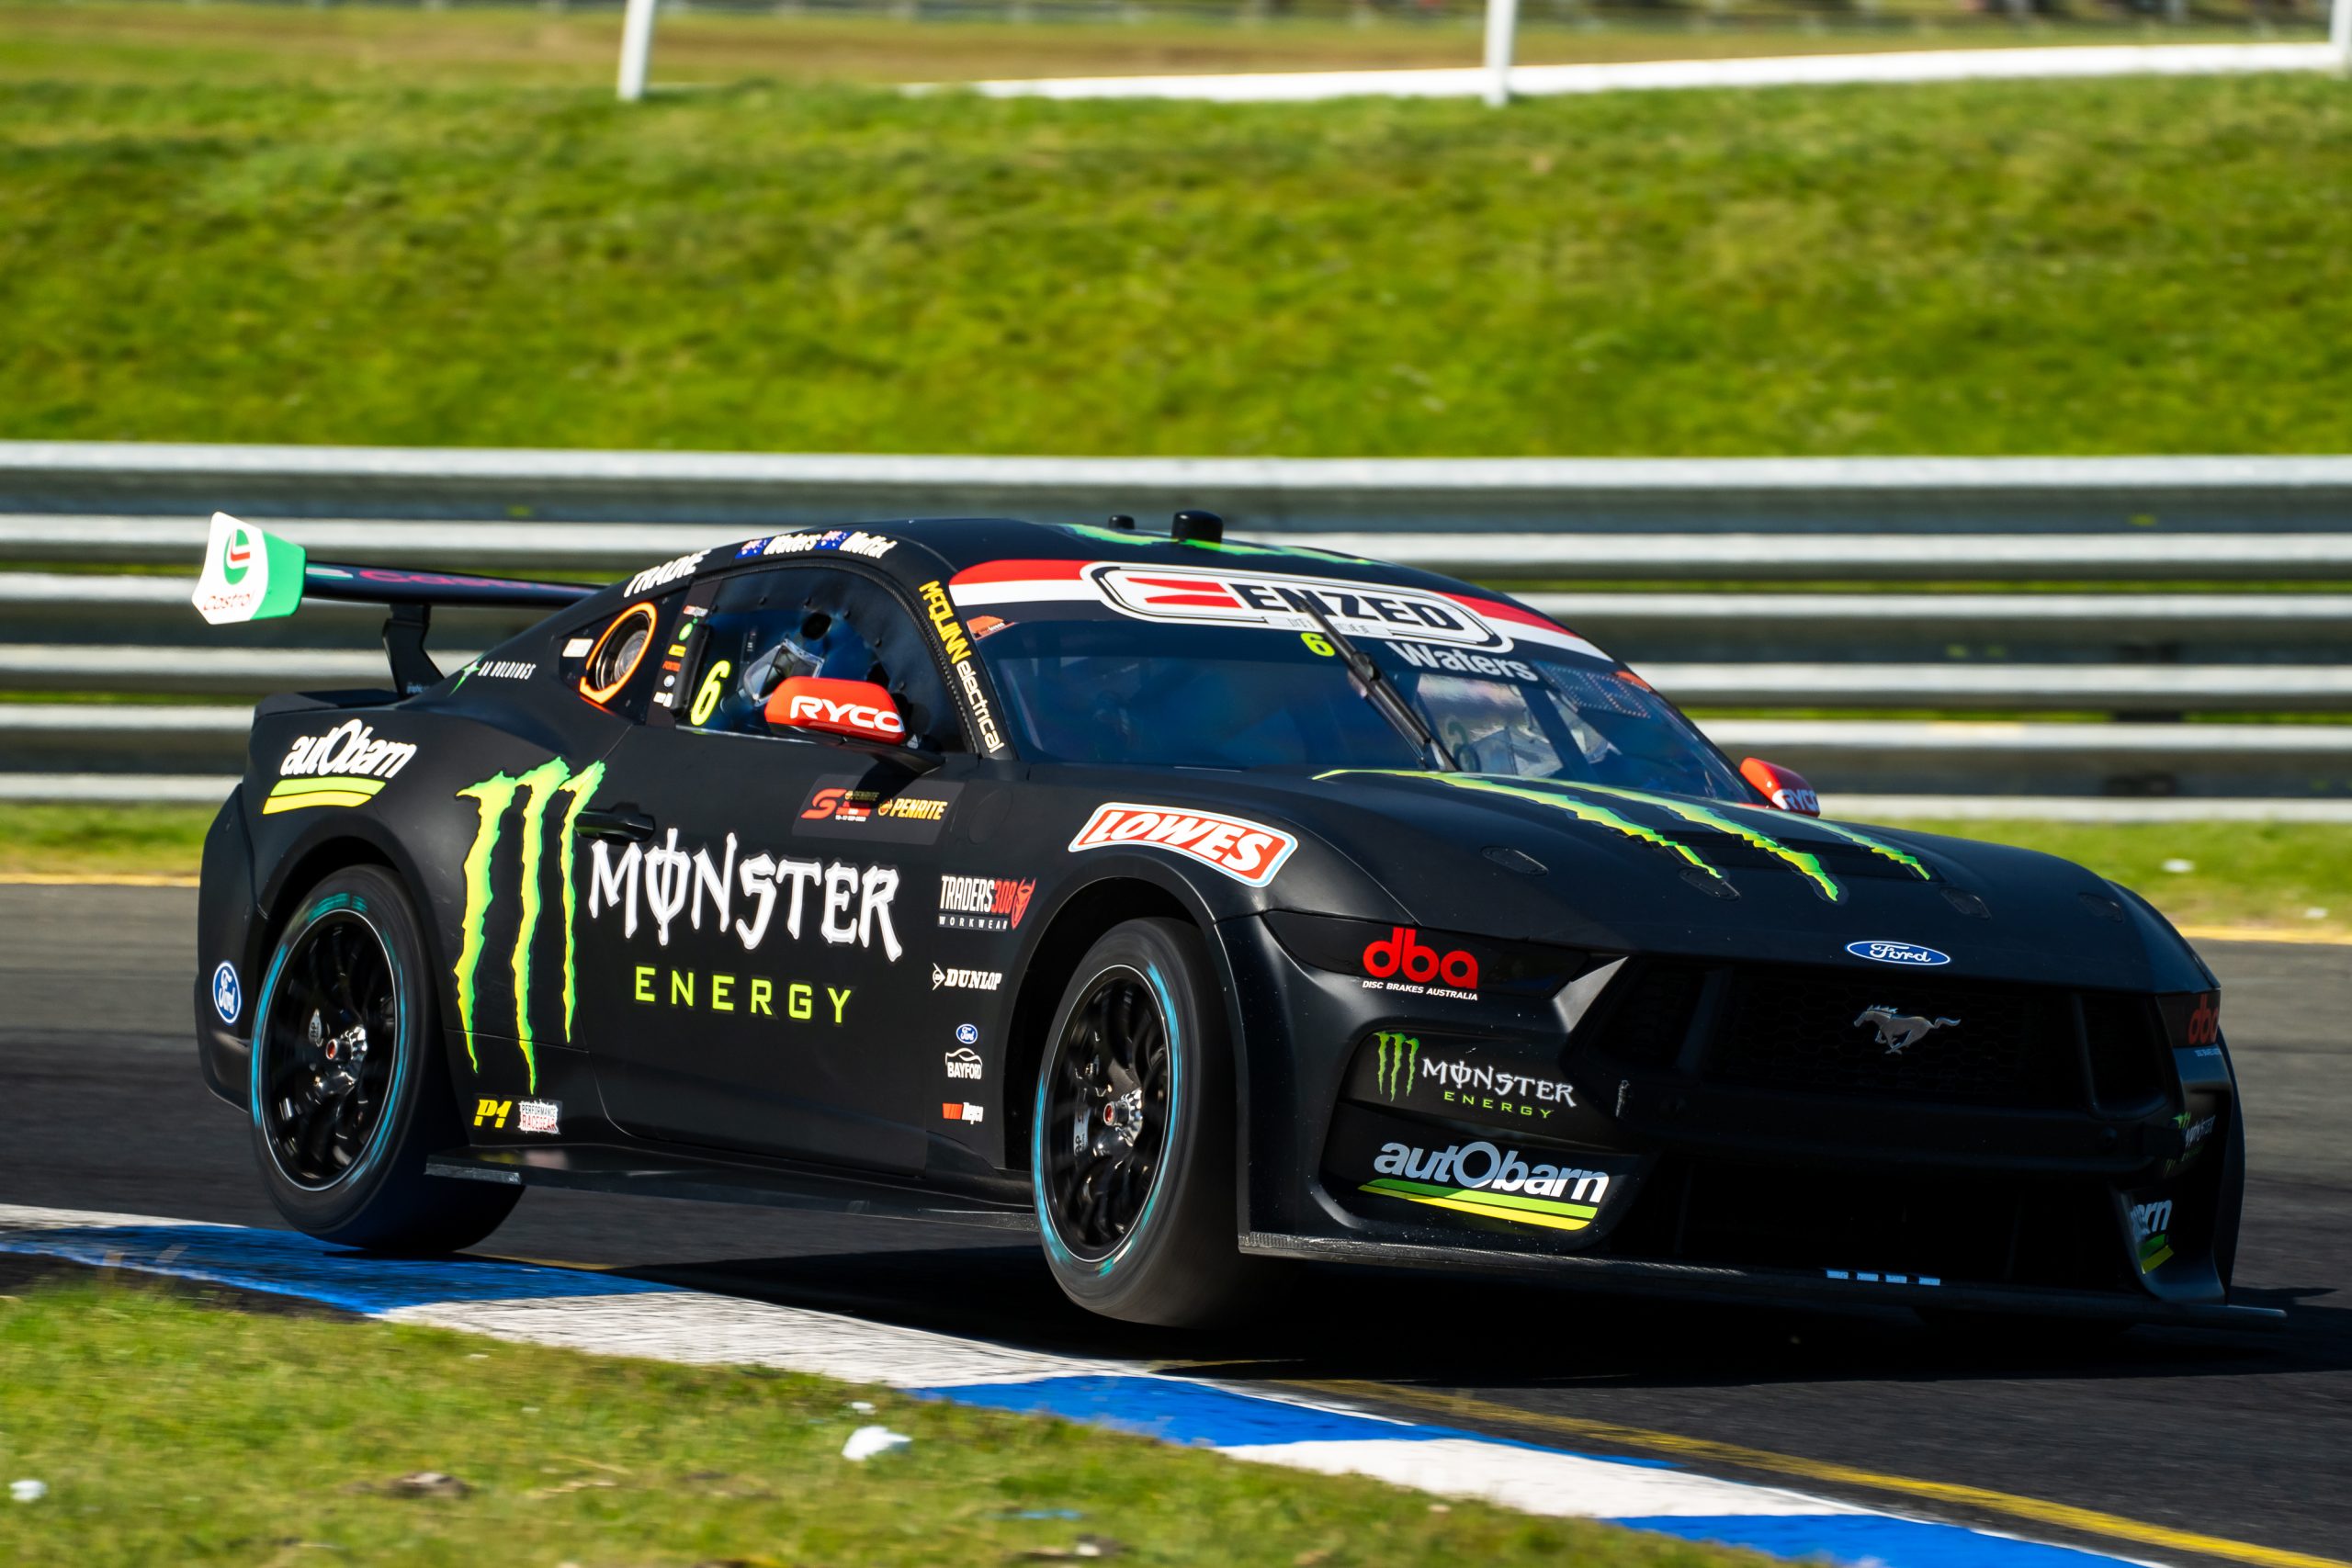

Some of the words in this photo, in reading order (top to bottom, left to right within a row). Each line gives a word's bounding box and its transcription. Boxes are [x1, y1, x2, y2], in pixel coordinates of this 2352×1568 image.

[623, 548, 711, 598] TRADIE
[1229, 582, 1463, 631] ENZED
[1300, 632, 1336, 658] 6
[1384, 640, 1539, 682] Waters
[691, 660, 731, 726] 6
[956, 660, 1005, 754] electrical
[790, 695, 904, 732] RYCO
[889, 798, 948, 820] PENRITE
[1085, 812, 1273, 872] LOWES
[939, 916, 1007, 929] WORKWEAR
[1363, 927, 1478, 987] dba
[1870, 944, 1931, 964] Ford
[944, 969, 1001, 989] DUNLOP
[1363, 980, 1384, 988] DISC
[1386, 982, 1424, 994] BRAKES
[1426, 987, 1478, 1001] AUSTRALIA
[635, 966, 852, 1024] ENERGY
[947, 1061, 982, 1080] BAYFORD
[473, 1099, 513, 1128] P1
[522, 1104, 556, 1118] PERFORMANCE
[1444, 1090, 1554, 1119] ENERGY
[522, 1114, 556, 1132] RACEGEAR
